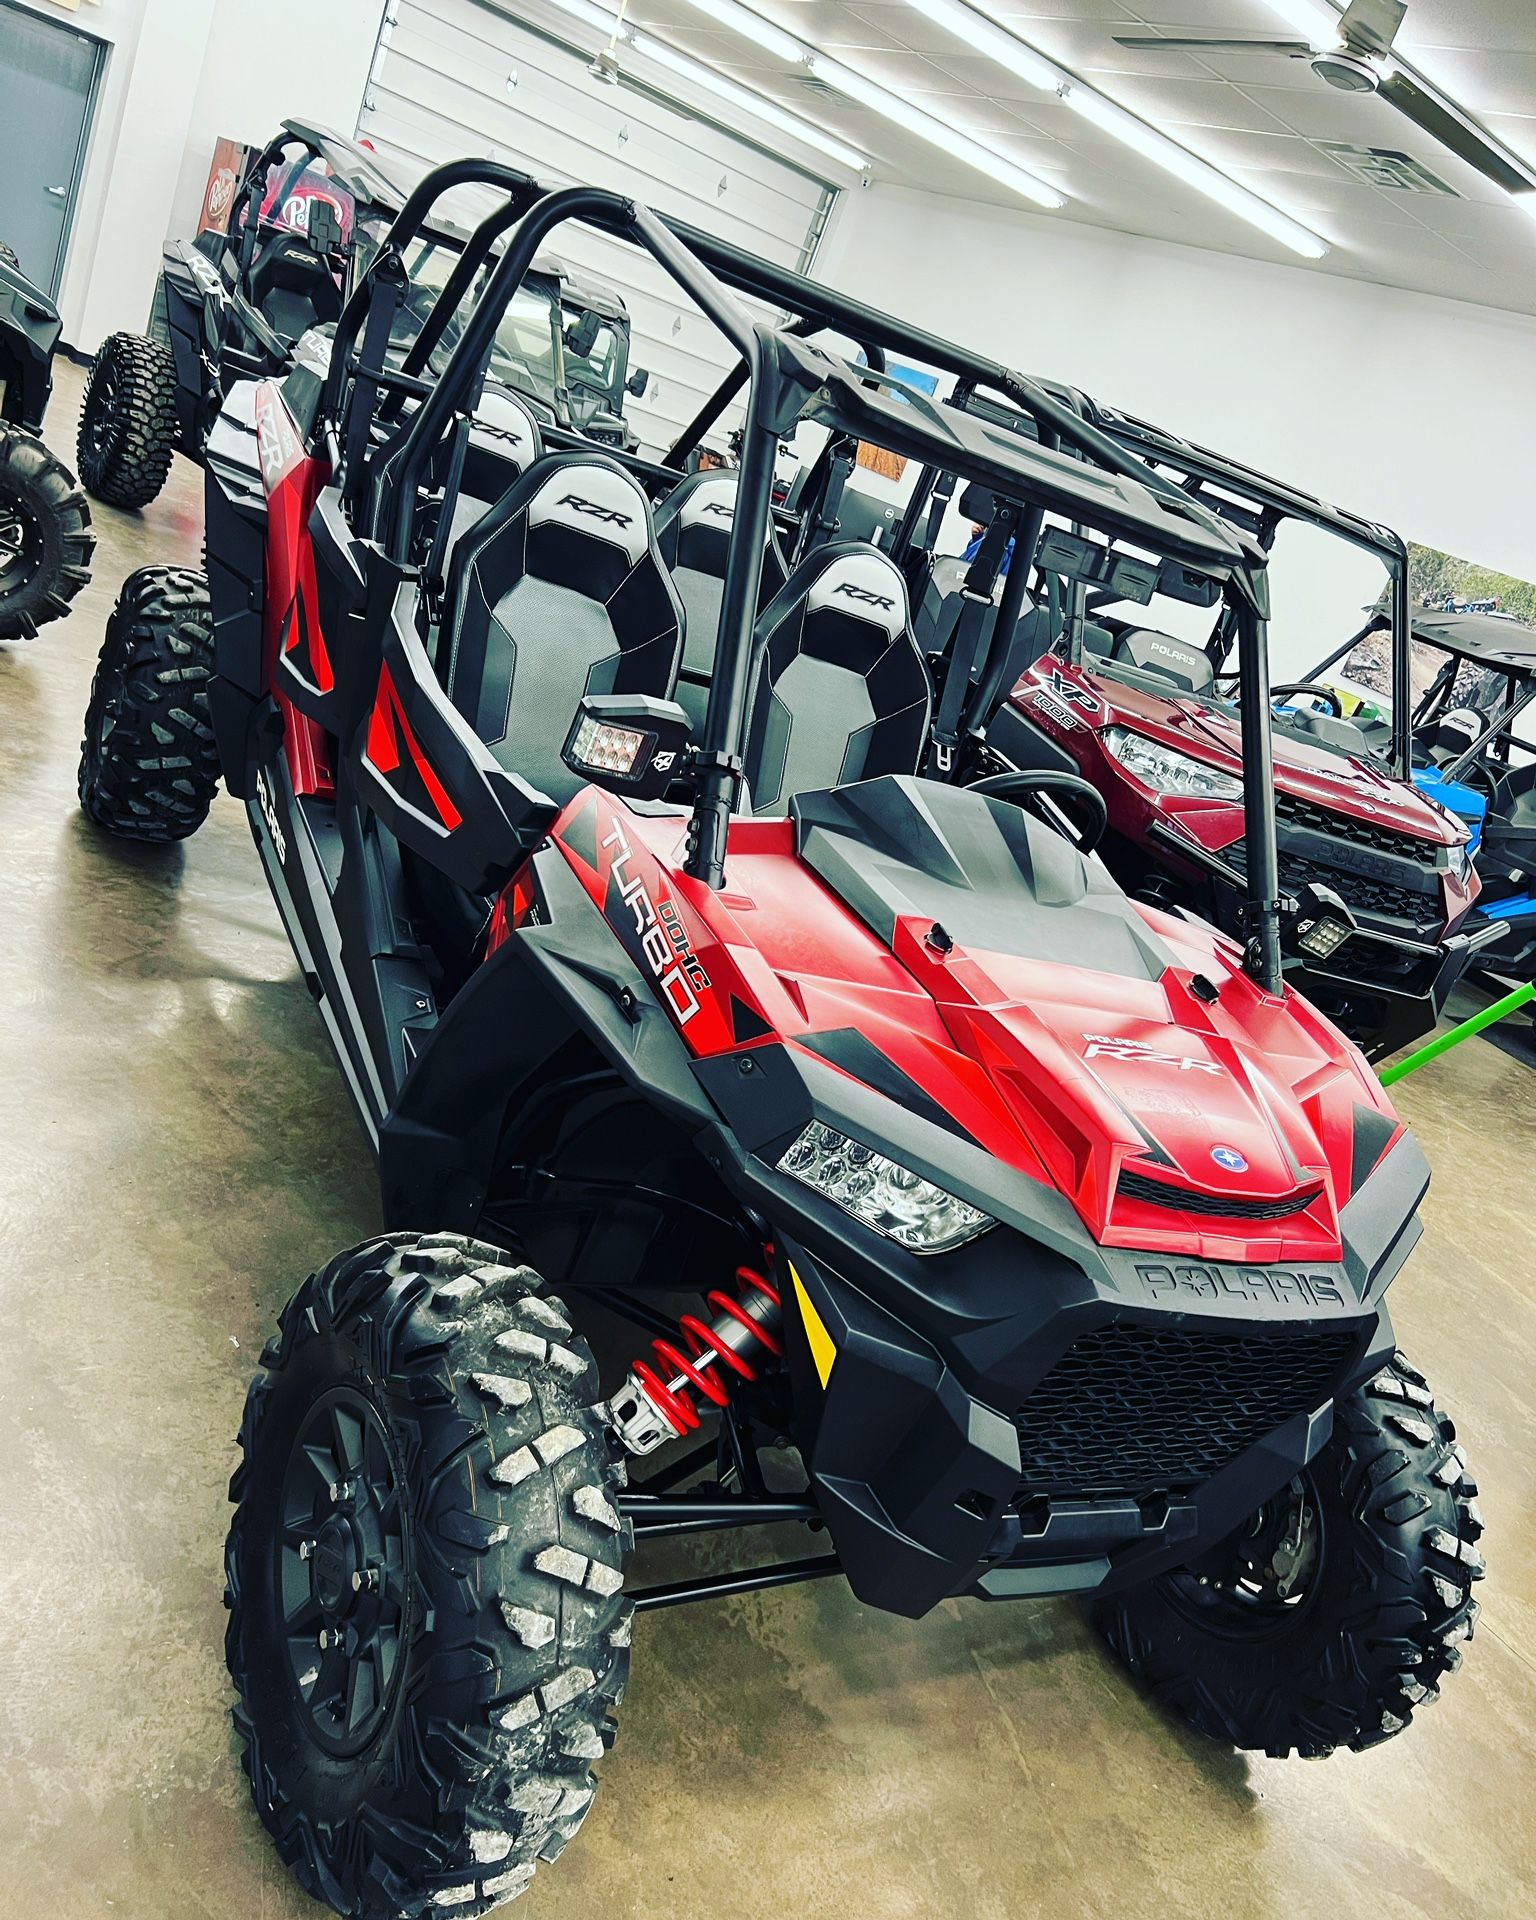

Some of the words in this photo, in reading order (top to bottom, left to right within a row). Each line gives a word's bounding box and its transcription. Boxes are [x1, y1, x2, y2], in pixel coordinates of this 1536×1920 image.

[284, 249, 318, 265] RZR
[186, 256, 232, 312] RZR
[257, 403, 285, 477] RZR
[556, 495, 633, 531] RZR
[702, 503, 735, 520] RZ
[831, 583, 895, 611] RZR
[1151, 642, 1196, 666] POLARIS
[1052, 668, 1101, 714] XP
[1033, 694, 1078, 728] 1000
[1449, 717, 1475, 730] RZR
[256, 769, 286, 866] POLARIS
[1314, 840, 1407, 883] POLARIS
[601, 816, 701, 1025] TURBO
[657, 900, 712, 991] DOHC
[1081, 1033, 1153, 1051] POLARIS
[1082, 1042, 1226, 1078] RZR
[1134, 1265, 1345, 1307] POLARIS
